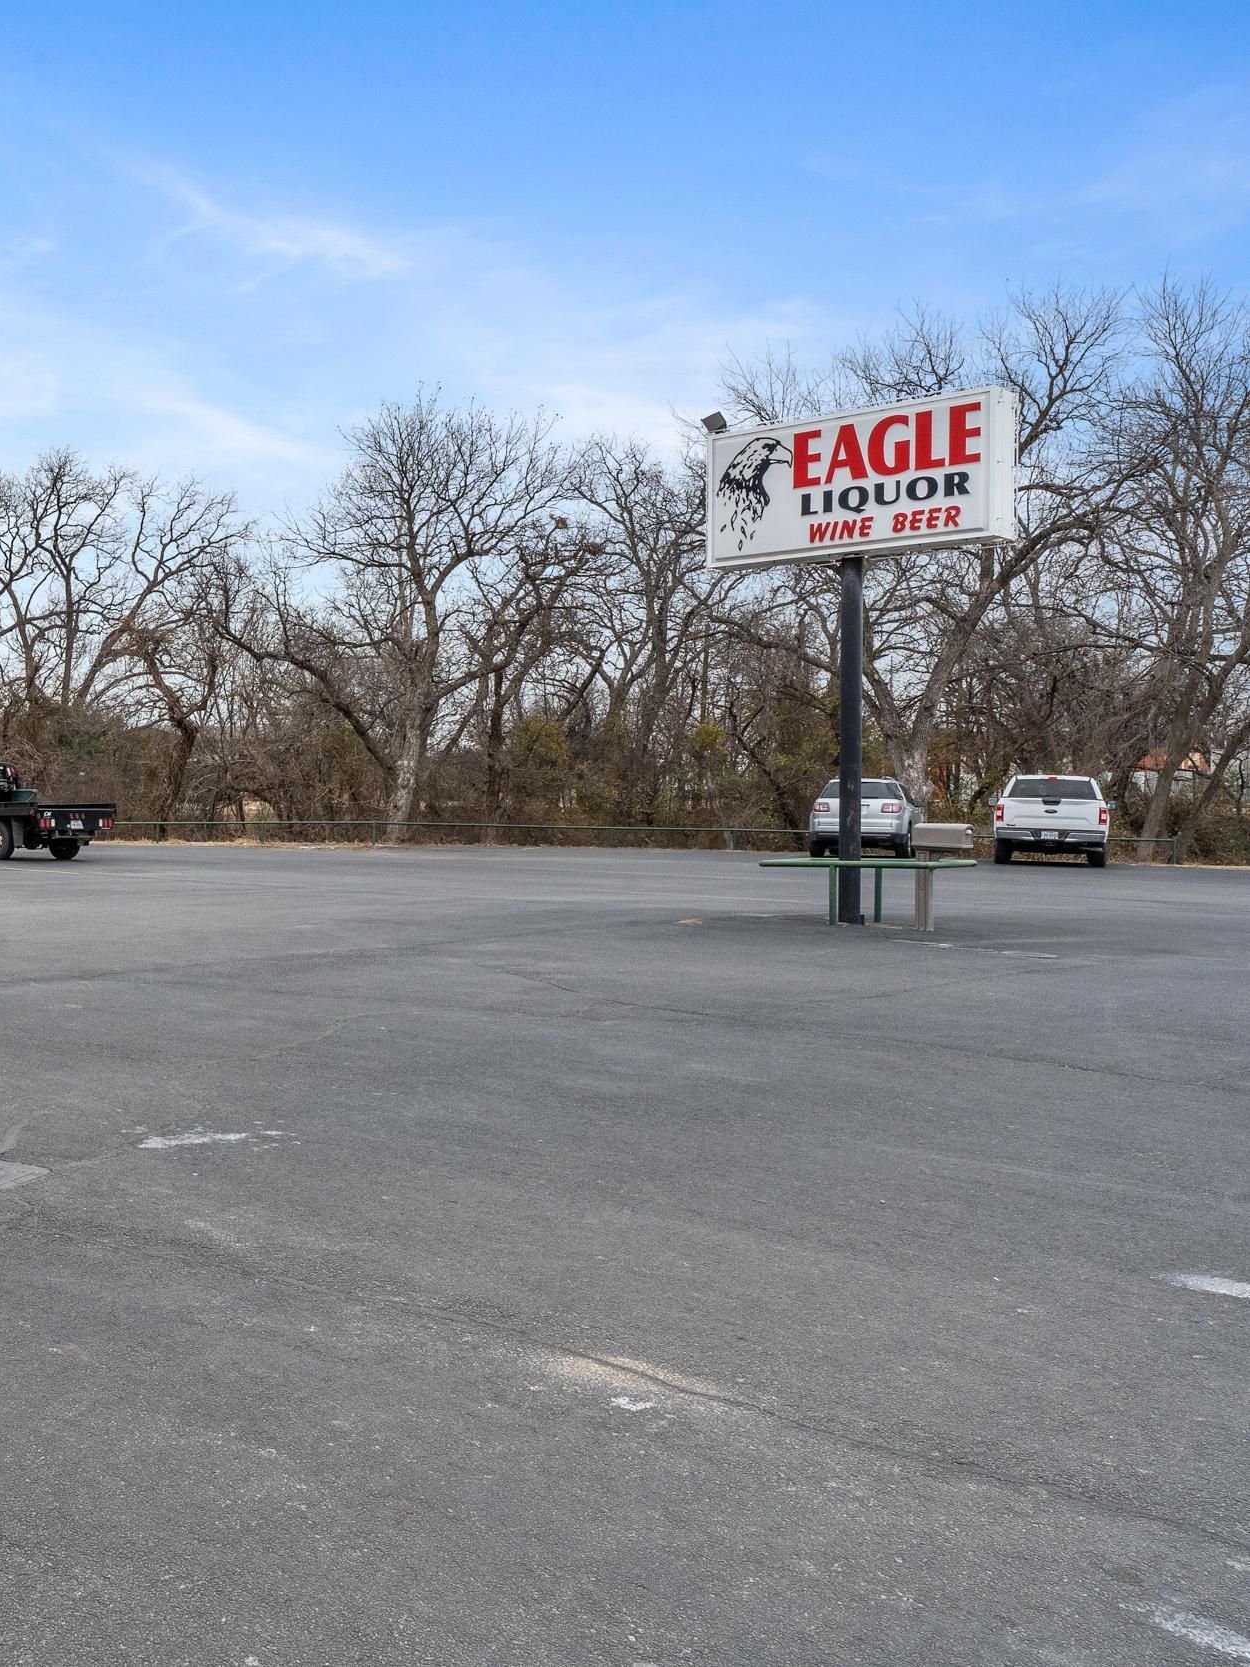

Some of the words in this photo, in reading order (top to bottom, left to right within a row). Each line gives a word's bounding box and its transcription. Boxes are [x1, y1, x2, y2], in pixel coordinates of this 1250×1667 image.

[793, 402, 981, 488] EAGLE
[801, 471, 970, 516] LIQUOR
[809, 516, 875, 543] WINE
[892, 505, 962, 533] BEER
